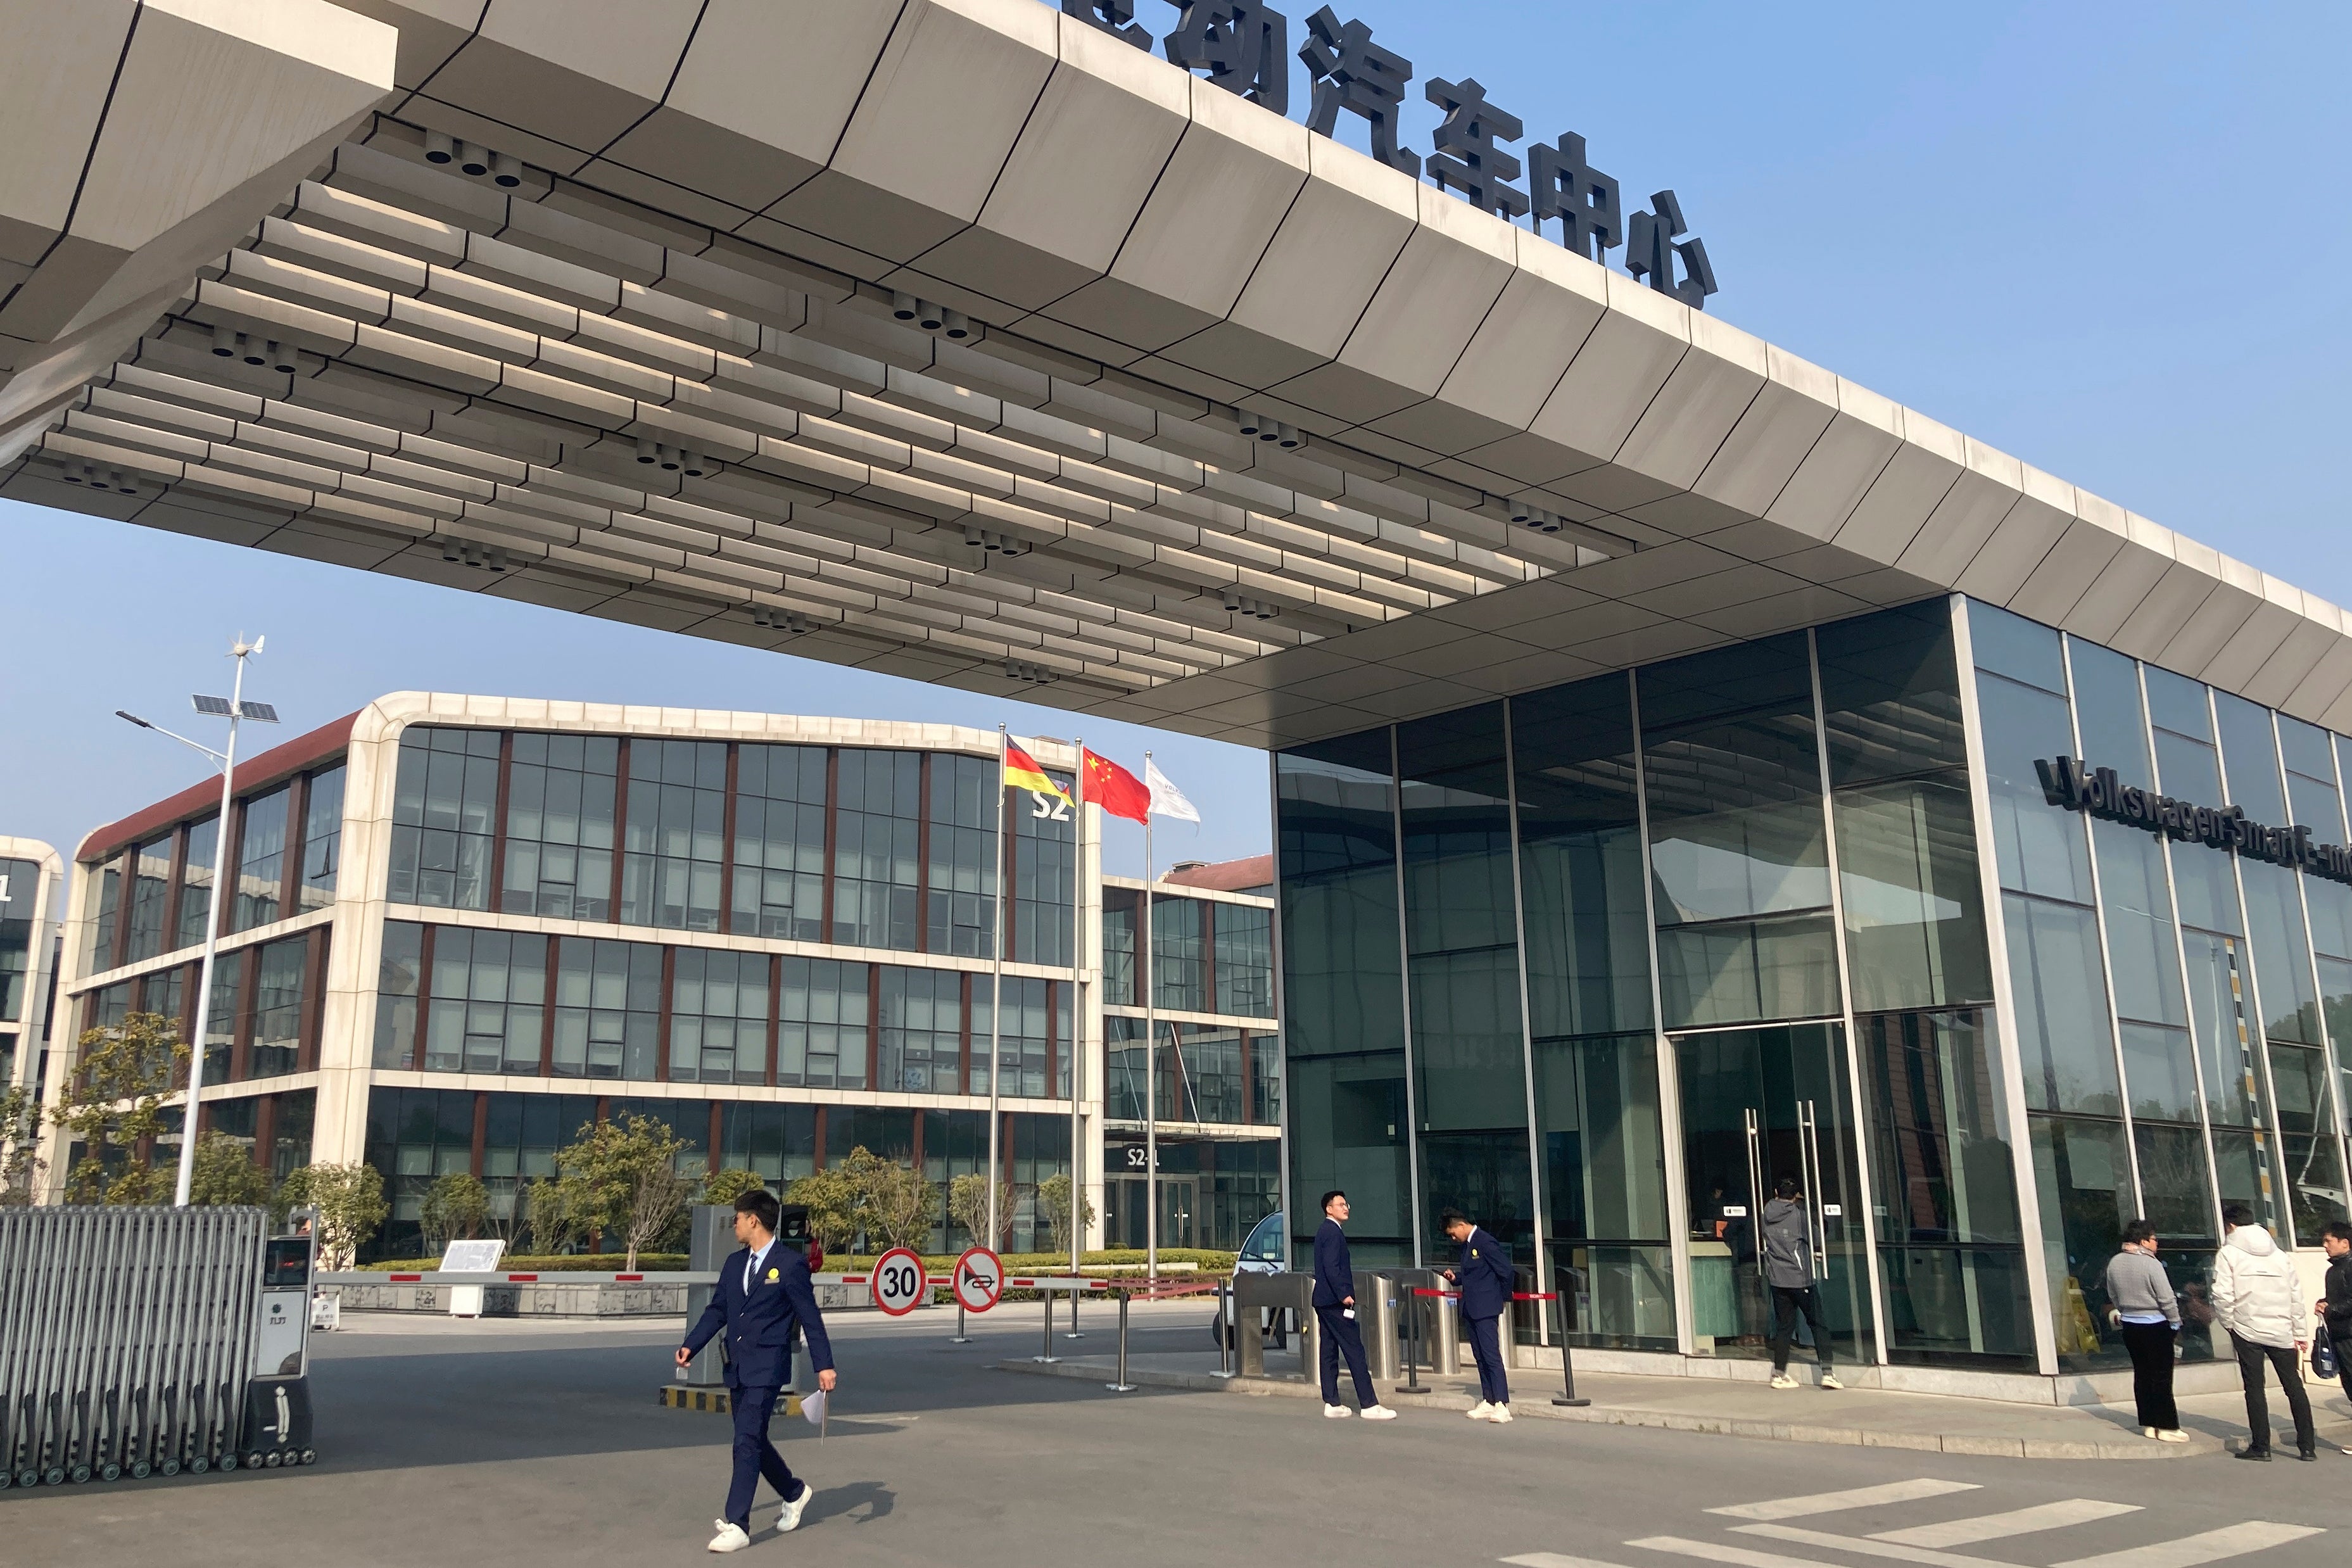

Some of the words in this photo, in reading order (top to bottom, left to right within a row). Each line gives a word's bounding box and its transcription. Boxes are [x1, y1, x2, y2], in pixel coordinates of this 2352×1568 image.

[1033, 790, 1069, 821] S2
[2052, 755, 2225, 843] Volkswagen
[2220, 805, 2301, 864] Smart
[883, 1266, 916, 1298] 30
